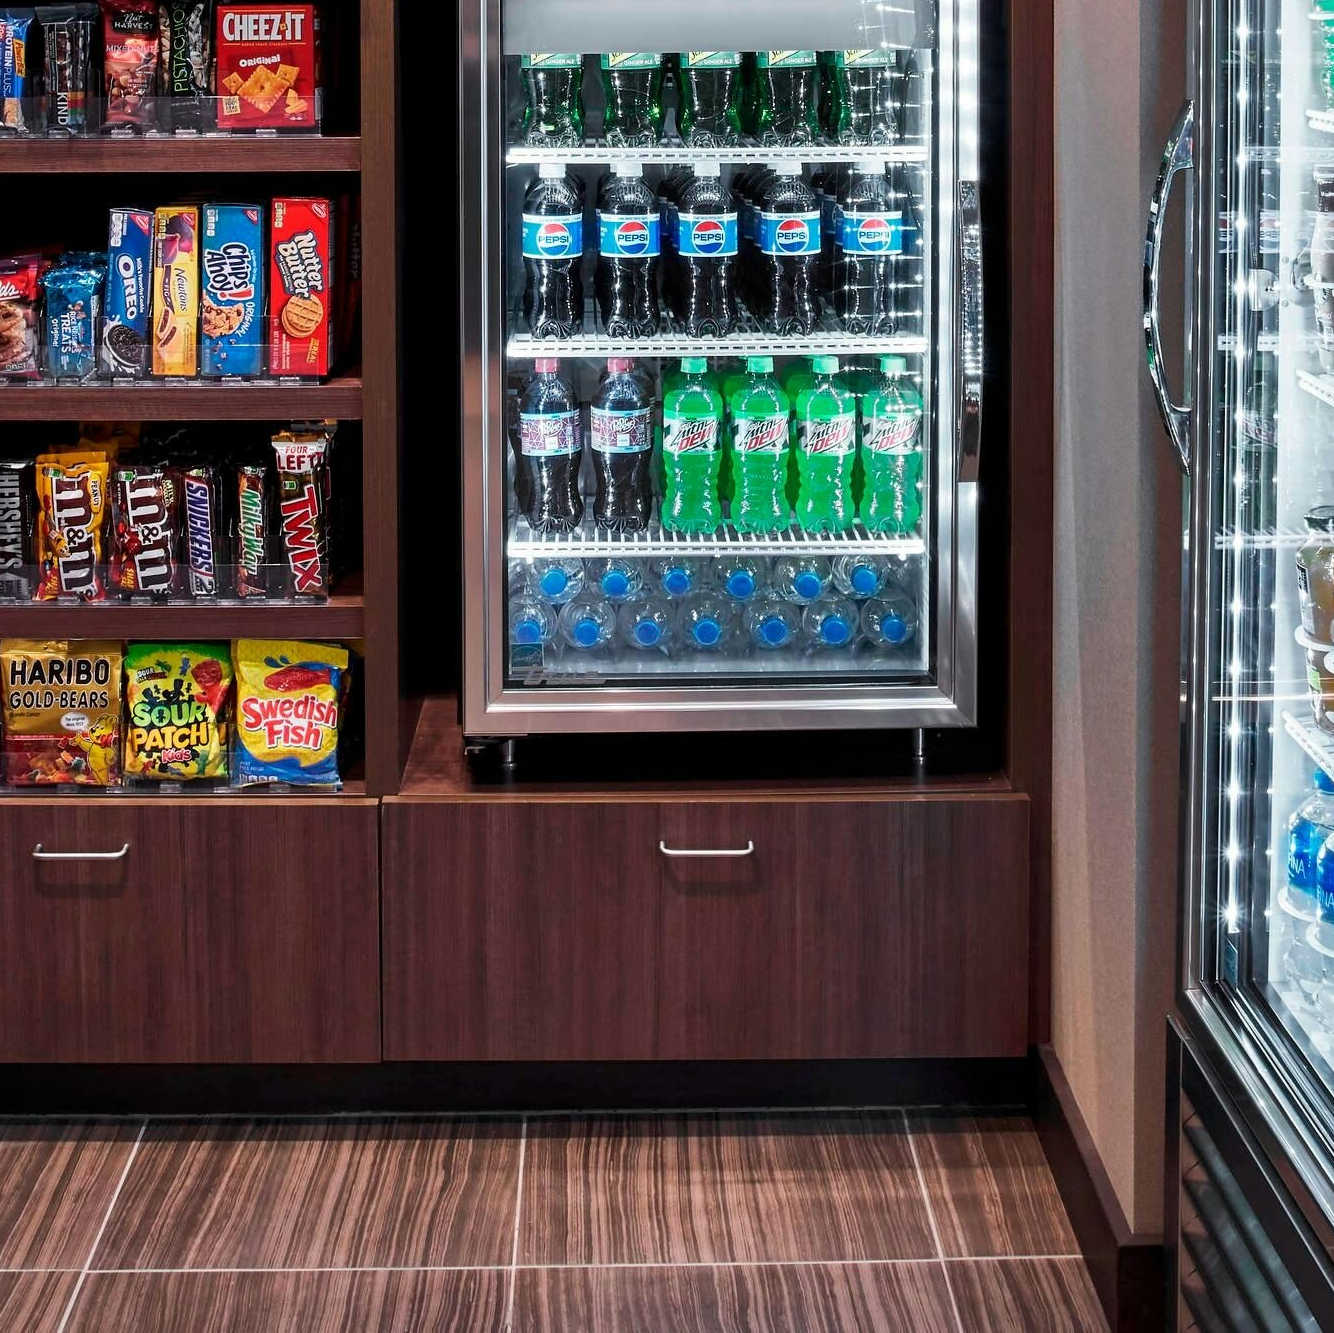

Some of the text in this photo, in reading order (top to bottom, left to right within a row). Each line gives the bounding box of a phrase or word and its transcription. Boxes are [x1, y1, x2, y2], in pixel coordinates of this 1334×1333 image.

[114, 21, 153, 30] HARVEST
[106, 44, 135, 53] MIXED
[173, 2, 188, 93] PISTACHIOS
[57, 91, 69, 126] KIND
[538, 234, 570, 244] PEPSI
[615, 233, 648, 243] PEPSI
[692, 232, 725, 242] PEPSI
[777, 230, 808, 241] PEPSI
[858, 230, 890, 240] PEPSI
[221, 242, 249, 290] Chips
[277, 242, 309, 298] Butter
[293, 231, 324, 292] Nutter
[117, 253, 138, 320] OREO
[174, 267, 188, 312] Newtons
[234, 301, 256, 337] ORIGINAL
[61, 314, 69, 354] TREATS
[285, 445, 309, 454] FOUR
[91, 480, 100, 507] PEANUT
[185, 479, 214, 575] SNICKERS
[280, 484, 323, 593] TWIX
[9, 659, 110, 686] HARIBO
[9, 690, 109, 710] GOLD-BEARS
[132, 701, 207, 727] SOUR
[242, 695, 338, 730] Swedish
[130, 722, 209, 752] PATCH
[264, 720, 323, 749] Fish
[161, 749, 192, 763] Kids
